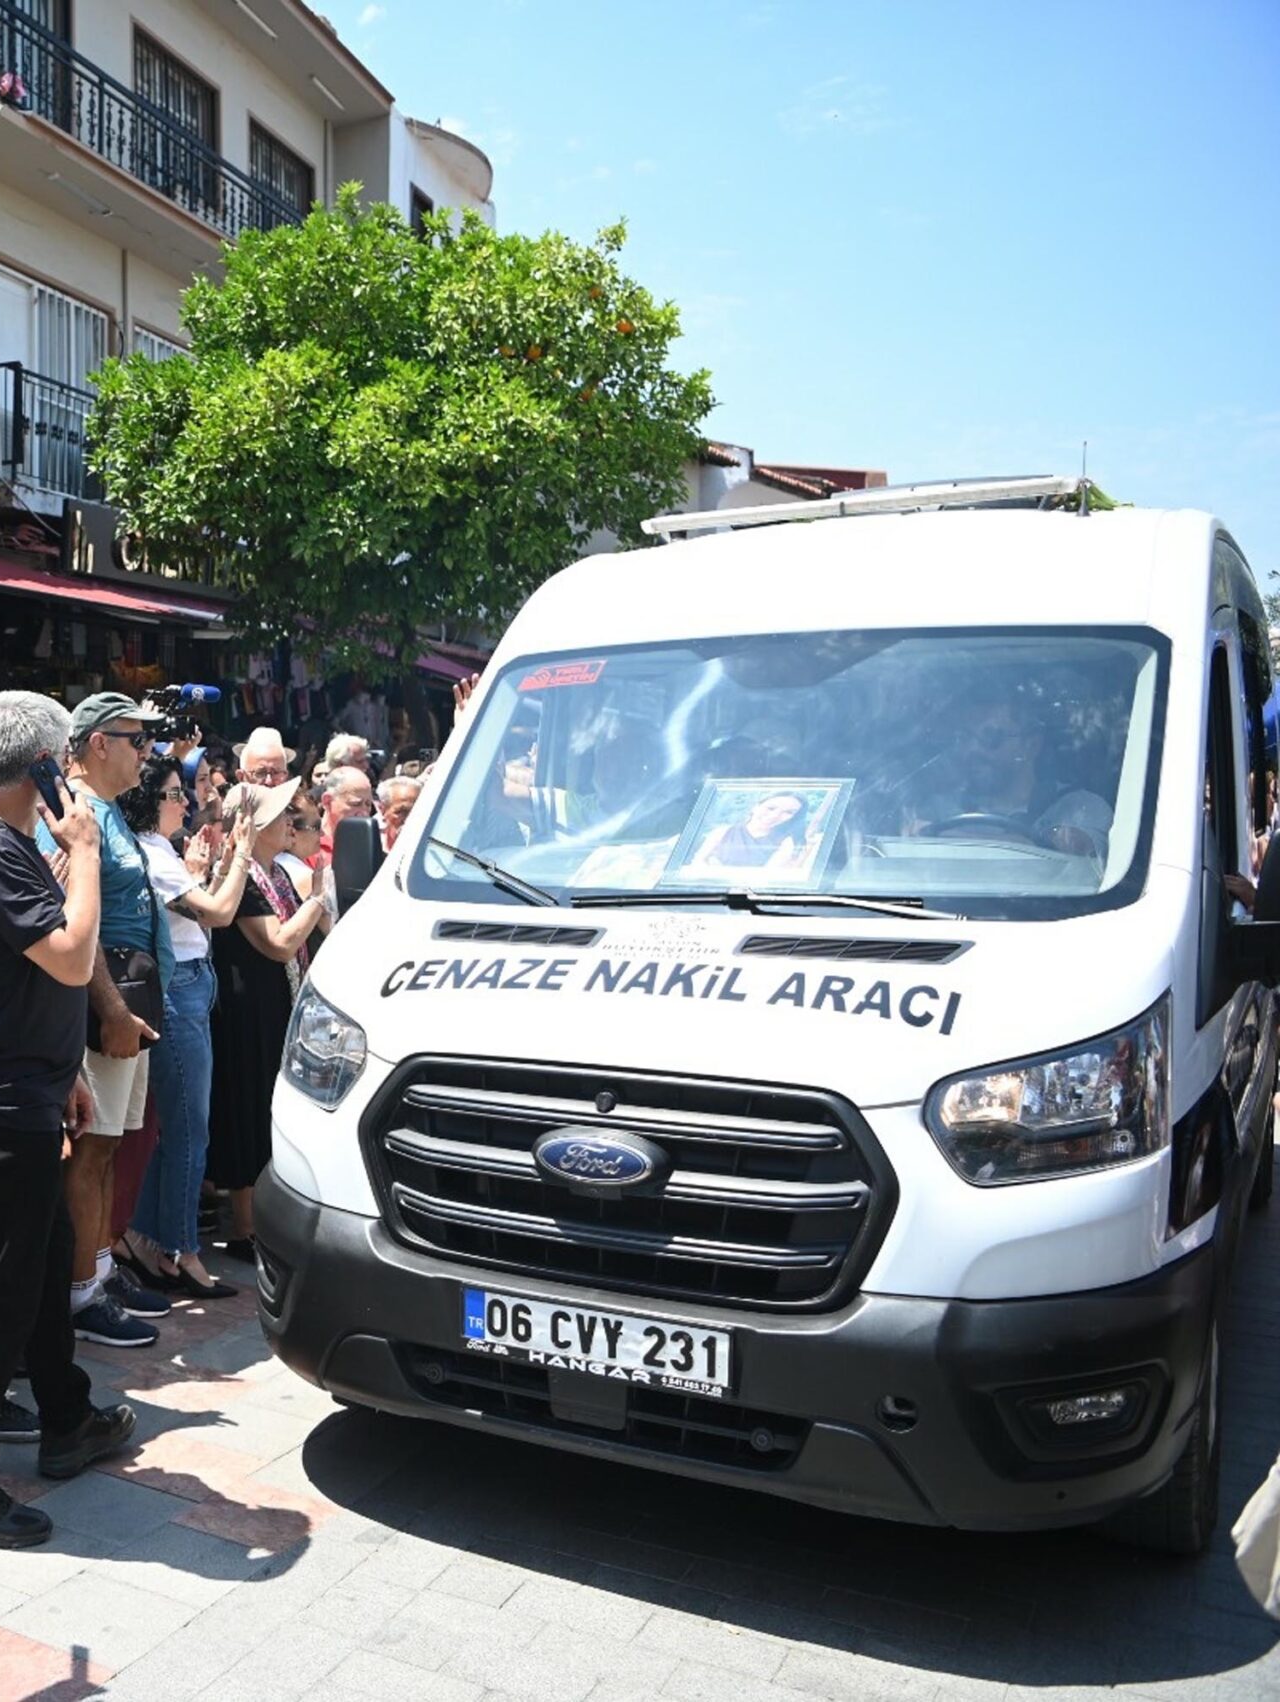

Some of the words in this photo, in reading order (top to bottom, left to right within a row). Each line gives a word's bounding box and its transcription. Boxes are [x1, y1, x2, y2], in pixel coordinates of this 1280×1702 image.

[380, 958, 578, 998] CENAZE
[766, 972, 962, 1036] ARACI
[559, 1143, 623, 1175] Ford
[468, 1315, 485, 1330] TR
[486, 1298, 532, 1343] 06
[551, 1310, 624, 1359] CVY
[642, 1325, 717, 1379] 231
[528, 1350, 651, 1385] HANGAR
